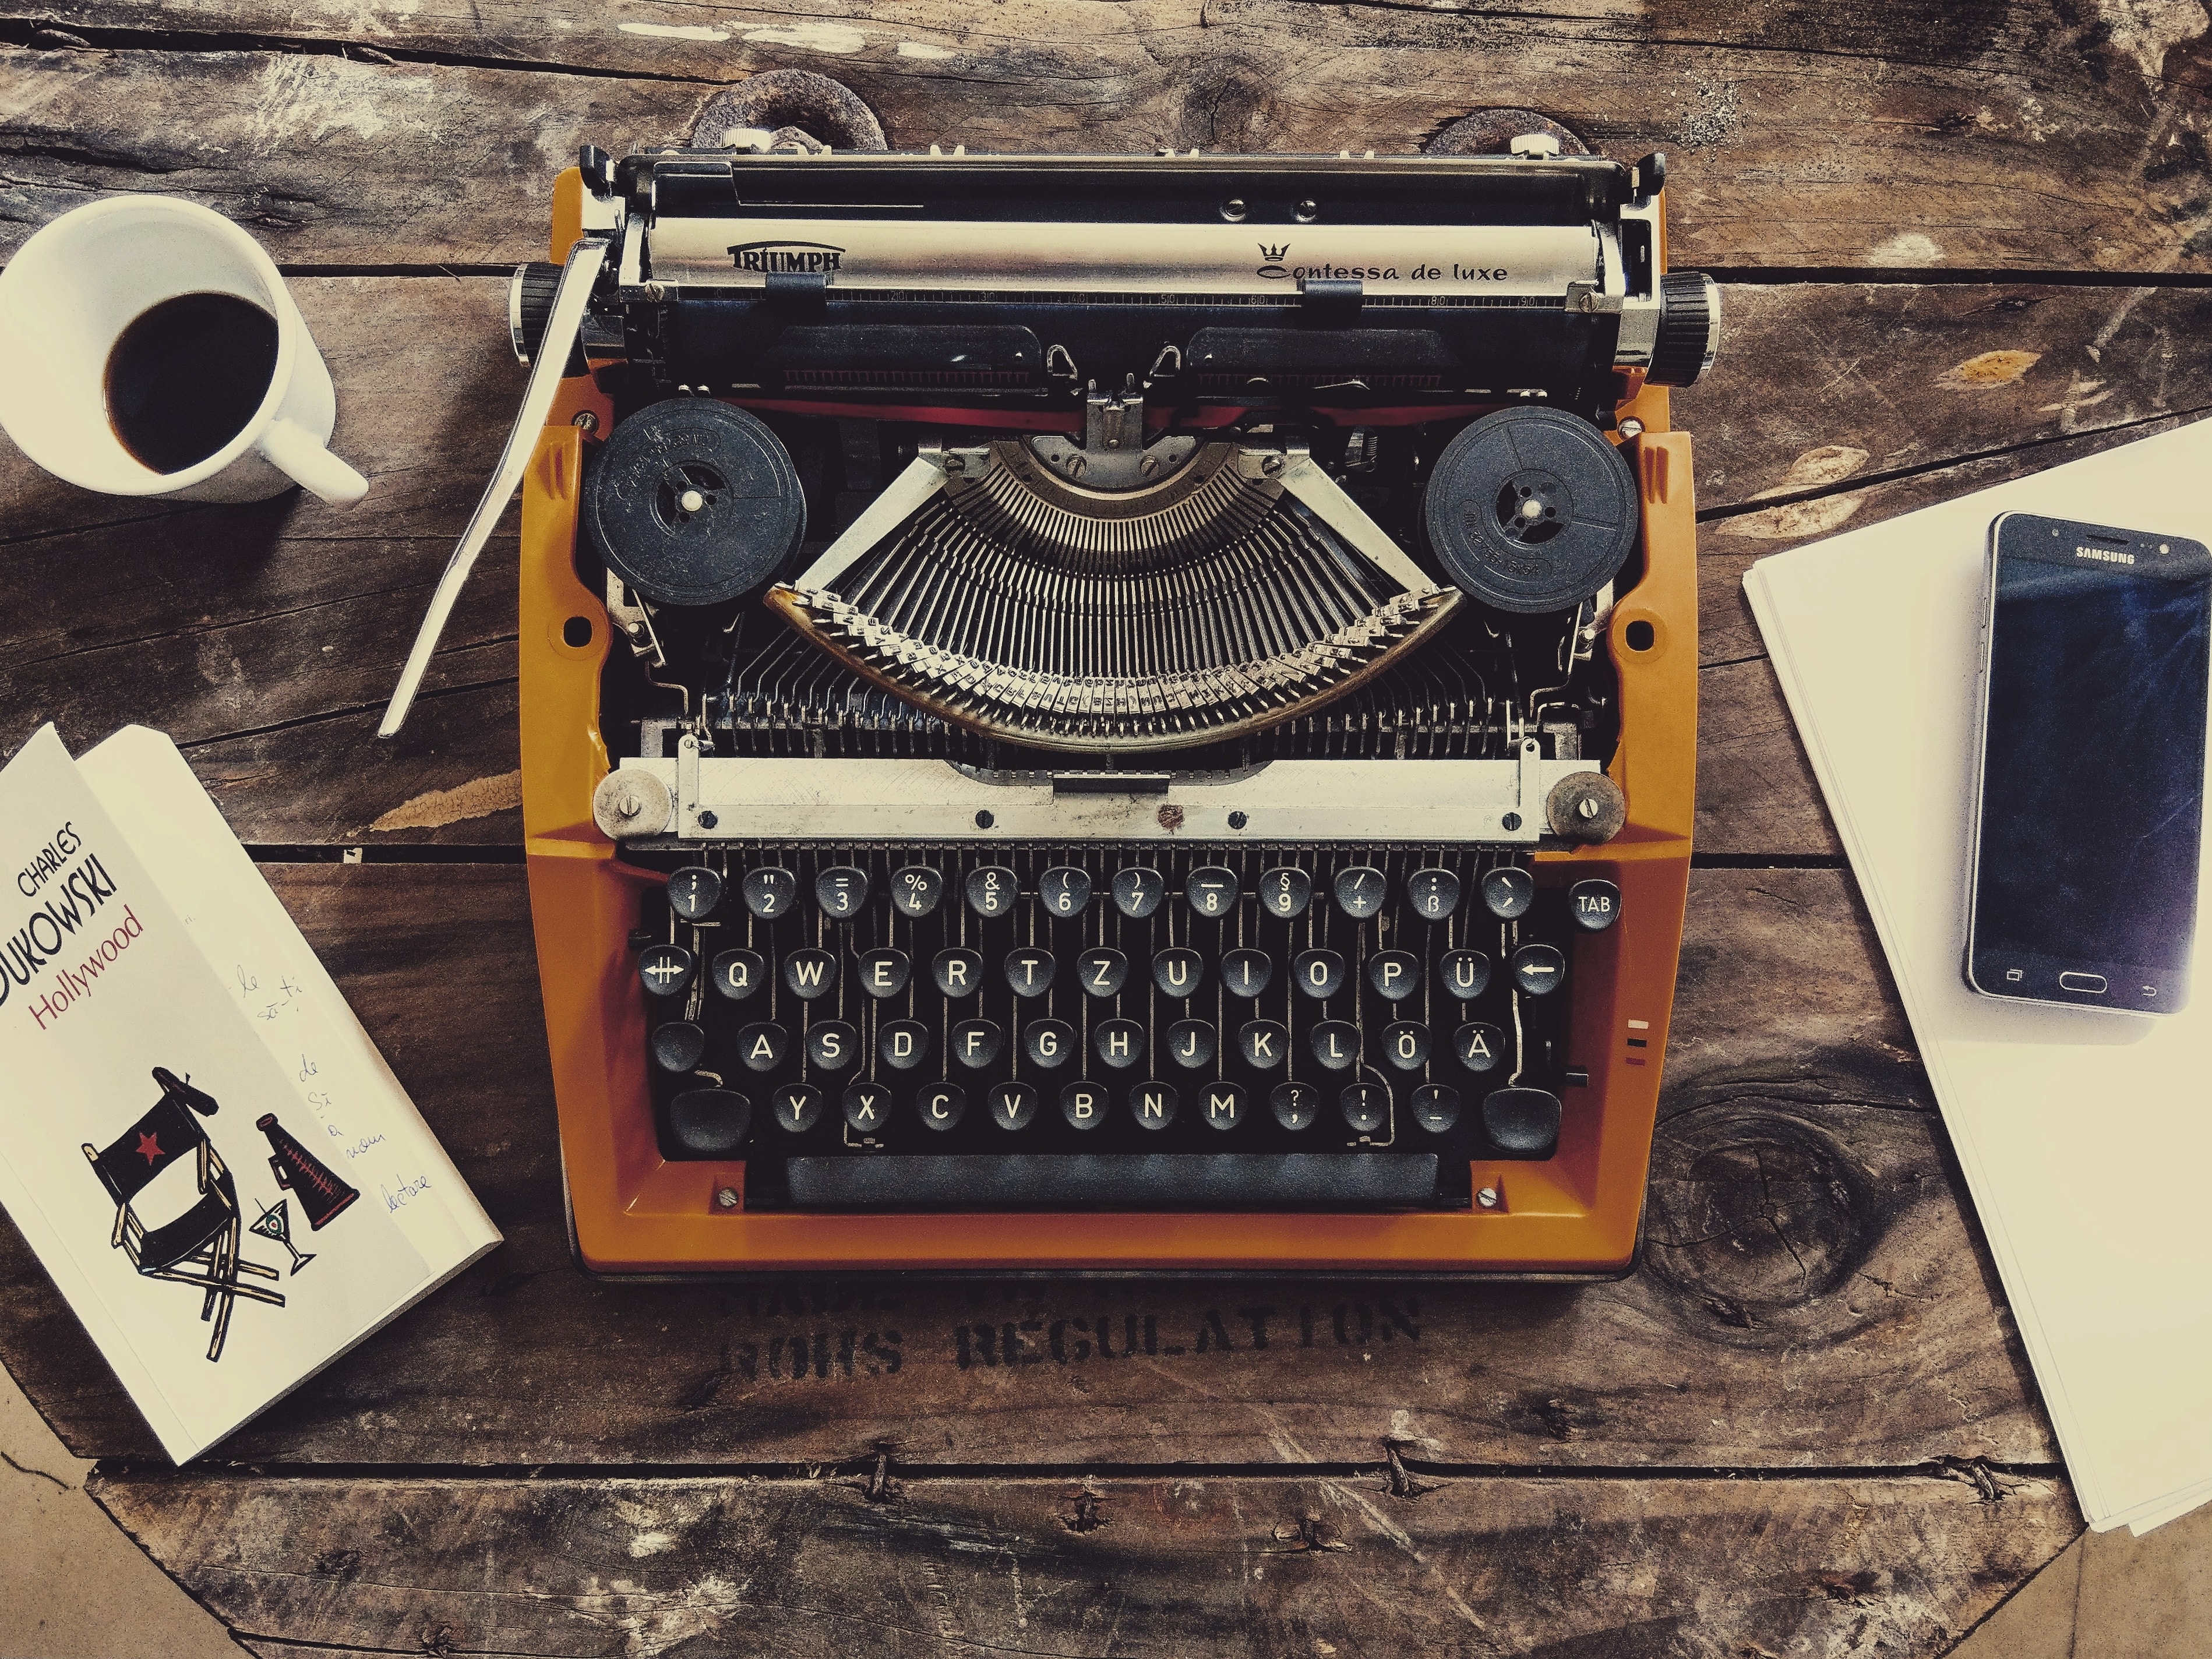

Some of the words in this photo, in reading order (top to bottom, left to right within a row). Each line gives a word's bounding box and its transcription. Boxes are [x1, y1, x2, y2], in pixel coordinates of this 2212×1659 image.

[727, 241, 845, 273] TRIUMPH
[1257, 263, 1399, 280] Contessa
[1411, 263, 1441, 280] de
[1454, 263, 1508, 281] luxe
[1160, 294, 1175, 303] 50
[1251, 294, 1265, 304] 60
[1431, 296, 1445, 306] 80
[1521, 296, 1536, 306] 90
[2076, 546, 2135, 565] SAMSUNG
[17, 821, 82, 897] CHARLES
[688, 894, 696, 912] 1
[763, 893, 775, 913] 2
[836, 891, 848, 911] 3
[908, 892, 922, 910] 4
[985, 891, 998, 910] 5
[1059, 892, 1071, 911] 6
[1131, 892, 1144, 911] 7
[1205, 892, 1218, 912] 8
[1278, 893, 1292, 912] 9
[1578, 896, 1610, 912] TAB
[28, 903, 143, 1030] Hollywood
[729, 962, 748, 987] Q
[796, 961, 824, 986] W
[874, 961, 892, 986] E
[948, 960, 966, 986] R
[1021, 960, 1038, 986] T
[1093, 961, 1110, 986] Z
[1168, 961, 1187, 986] U
[1244, 961, 1249, 985] I
[1310, 961, 1328, 986] O
[1384, 962, 1402, 987] P
[1456, 957, 1474, 987] Ü
[750, 1034, 773, 1060] A
[821, 1033, 840, 1058] S
[894, 1032, 912, 1057] D
[967, 1032, 985, 1057] F
[1039, 1032, 1057, 1056] G
[1110, 1032, 1128, 1057] H
[1181, 1032, 1195, 1057] J
[1254, 1032, 1272, 1057] K
[1330, 1033, 1343, 1058] L
[1398, 1030, 1416, 1058] Ö
[1468, 1030, 1491, 1058] Ä
[789, 1096, 806, 1120] Y
[858, 1095, 874, 1120] X
[932, 1095, 948, 1119] C
[1004, 1094, 1021, 1118] V
[1075, 1093, 1093, 1118] B
[1144, 1093, 1162, 1118] N
[1211, 1094, 1234, 1118] M
[955, 1296, 1421, 1369] REGULATION
